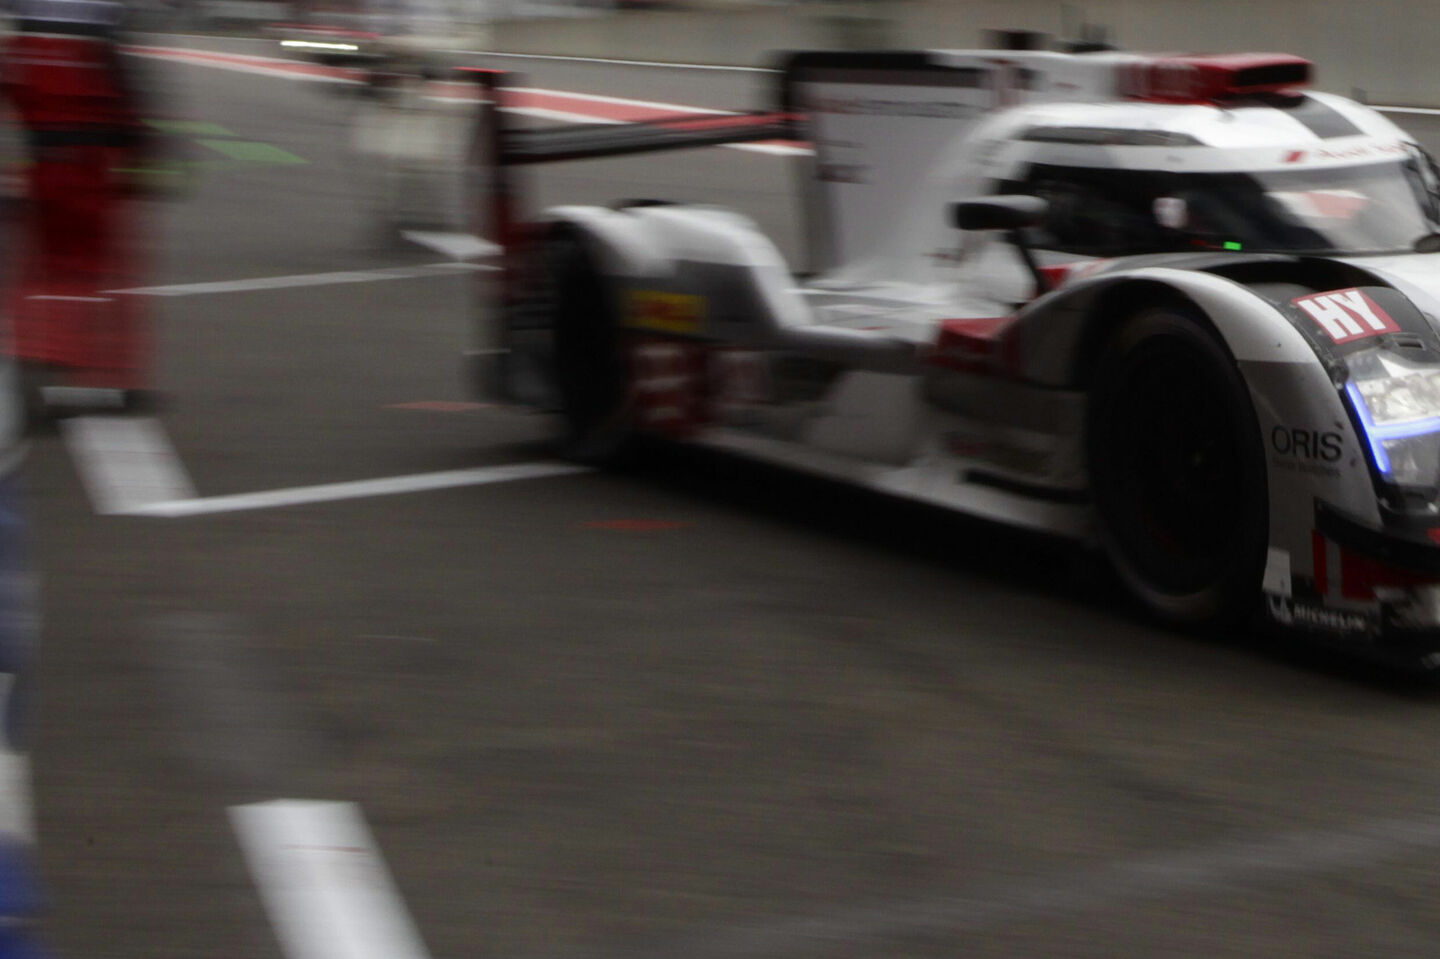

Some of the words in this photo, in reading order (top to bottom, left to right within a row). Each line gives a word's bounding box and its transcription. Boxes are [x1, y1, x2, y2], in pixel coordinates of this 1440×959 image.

[1298, 290, 1386, 340] HY
[1272, 424, 1343, 462] ORIS
[1294, 603, 1366, 631] MICHELIN
